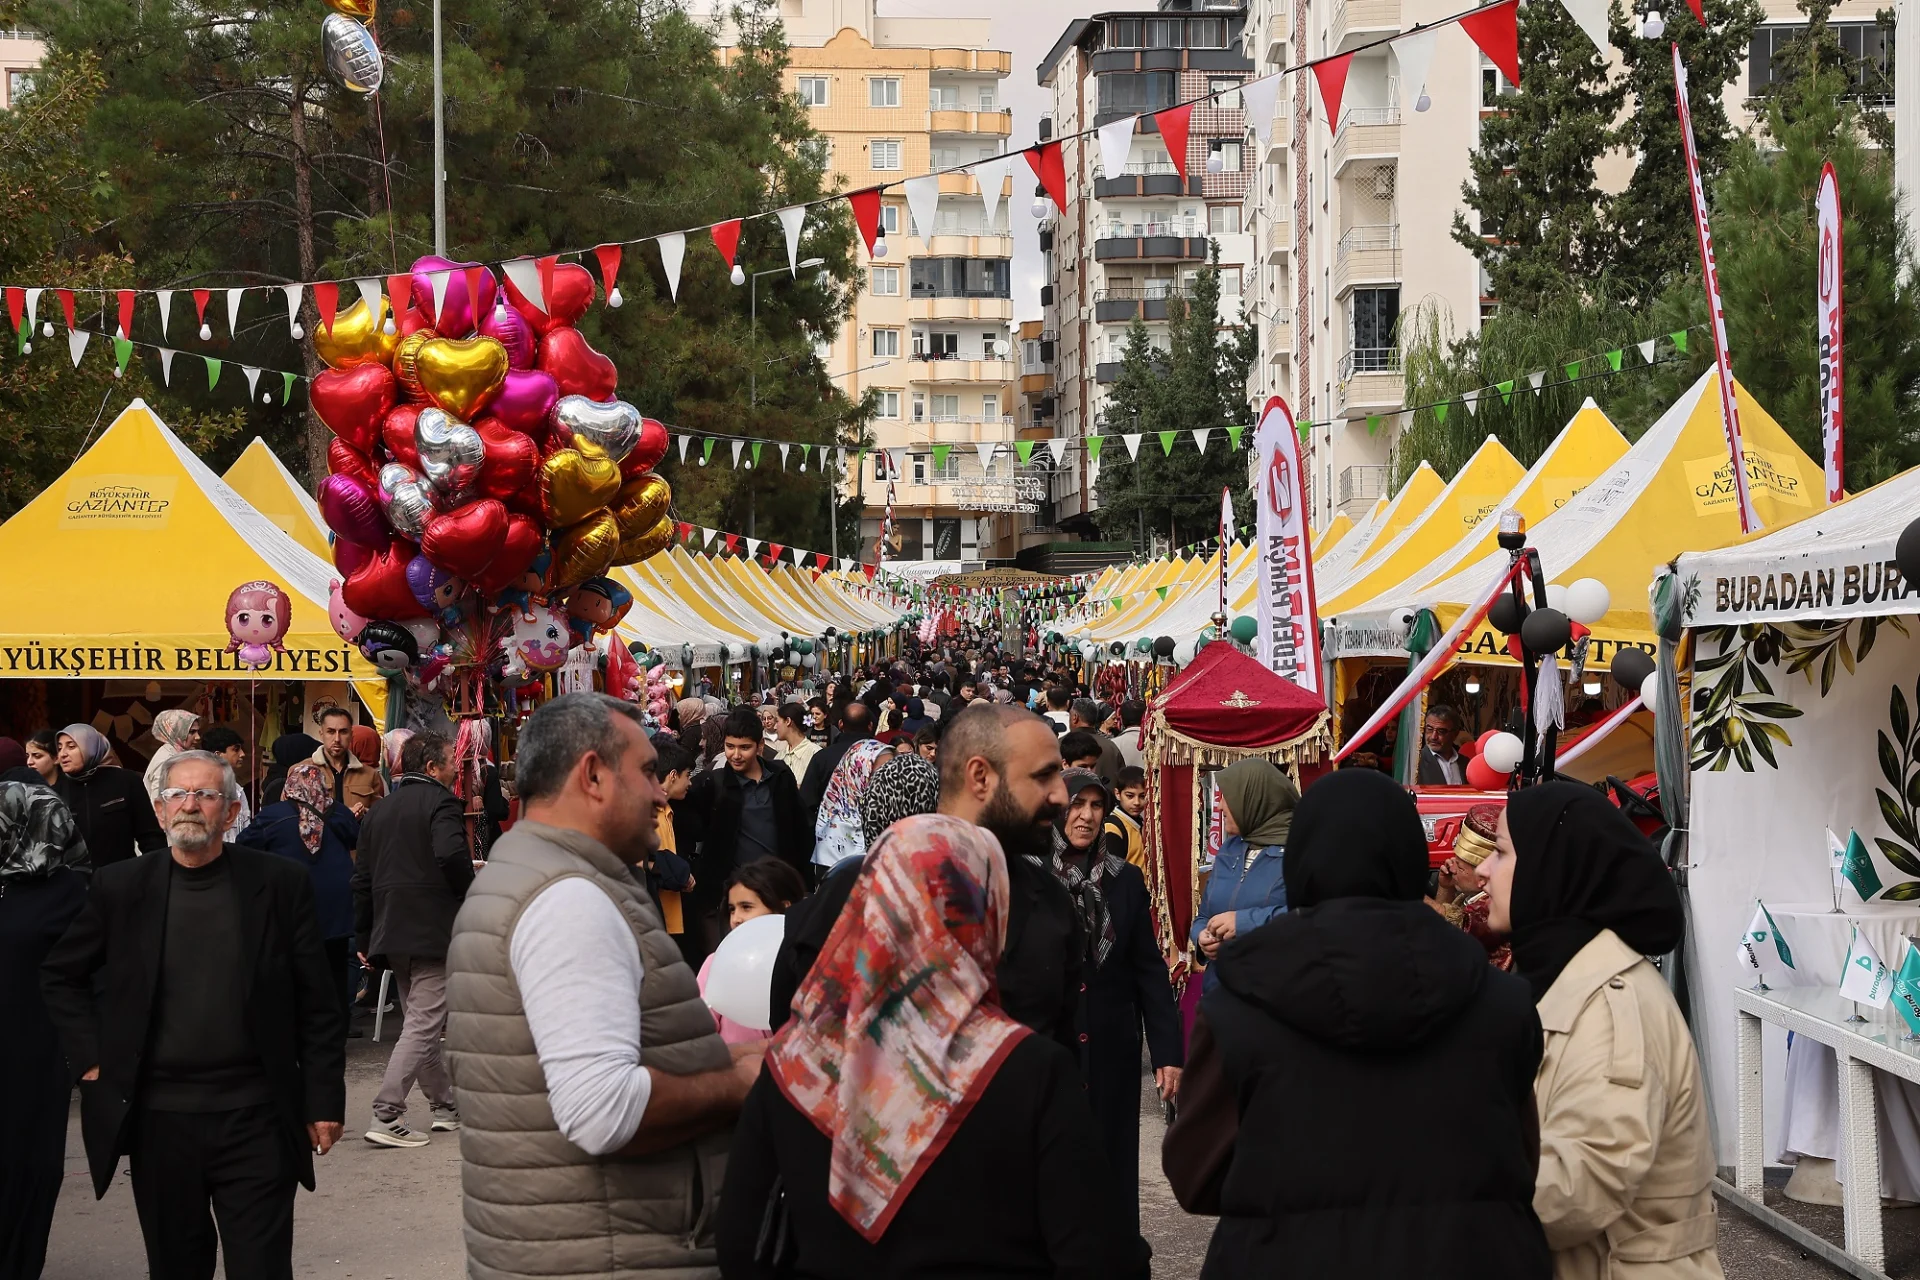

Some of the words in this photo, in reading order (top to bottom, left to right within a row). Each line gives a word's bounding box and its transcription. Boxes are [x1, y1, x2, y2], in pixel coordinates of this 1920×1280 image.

[1713, 457, 1775, 480] BÜYŞEHİR
[67, 498, 169, 513] GAZİANTEP
[1716, 568, 1834, 612] BURADAN
[0, 641, 165, 676] YÜKŞEHİR
